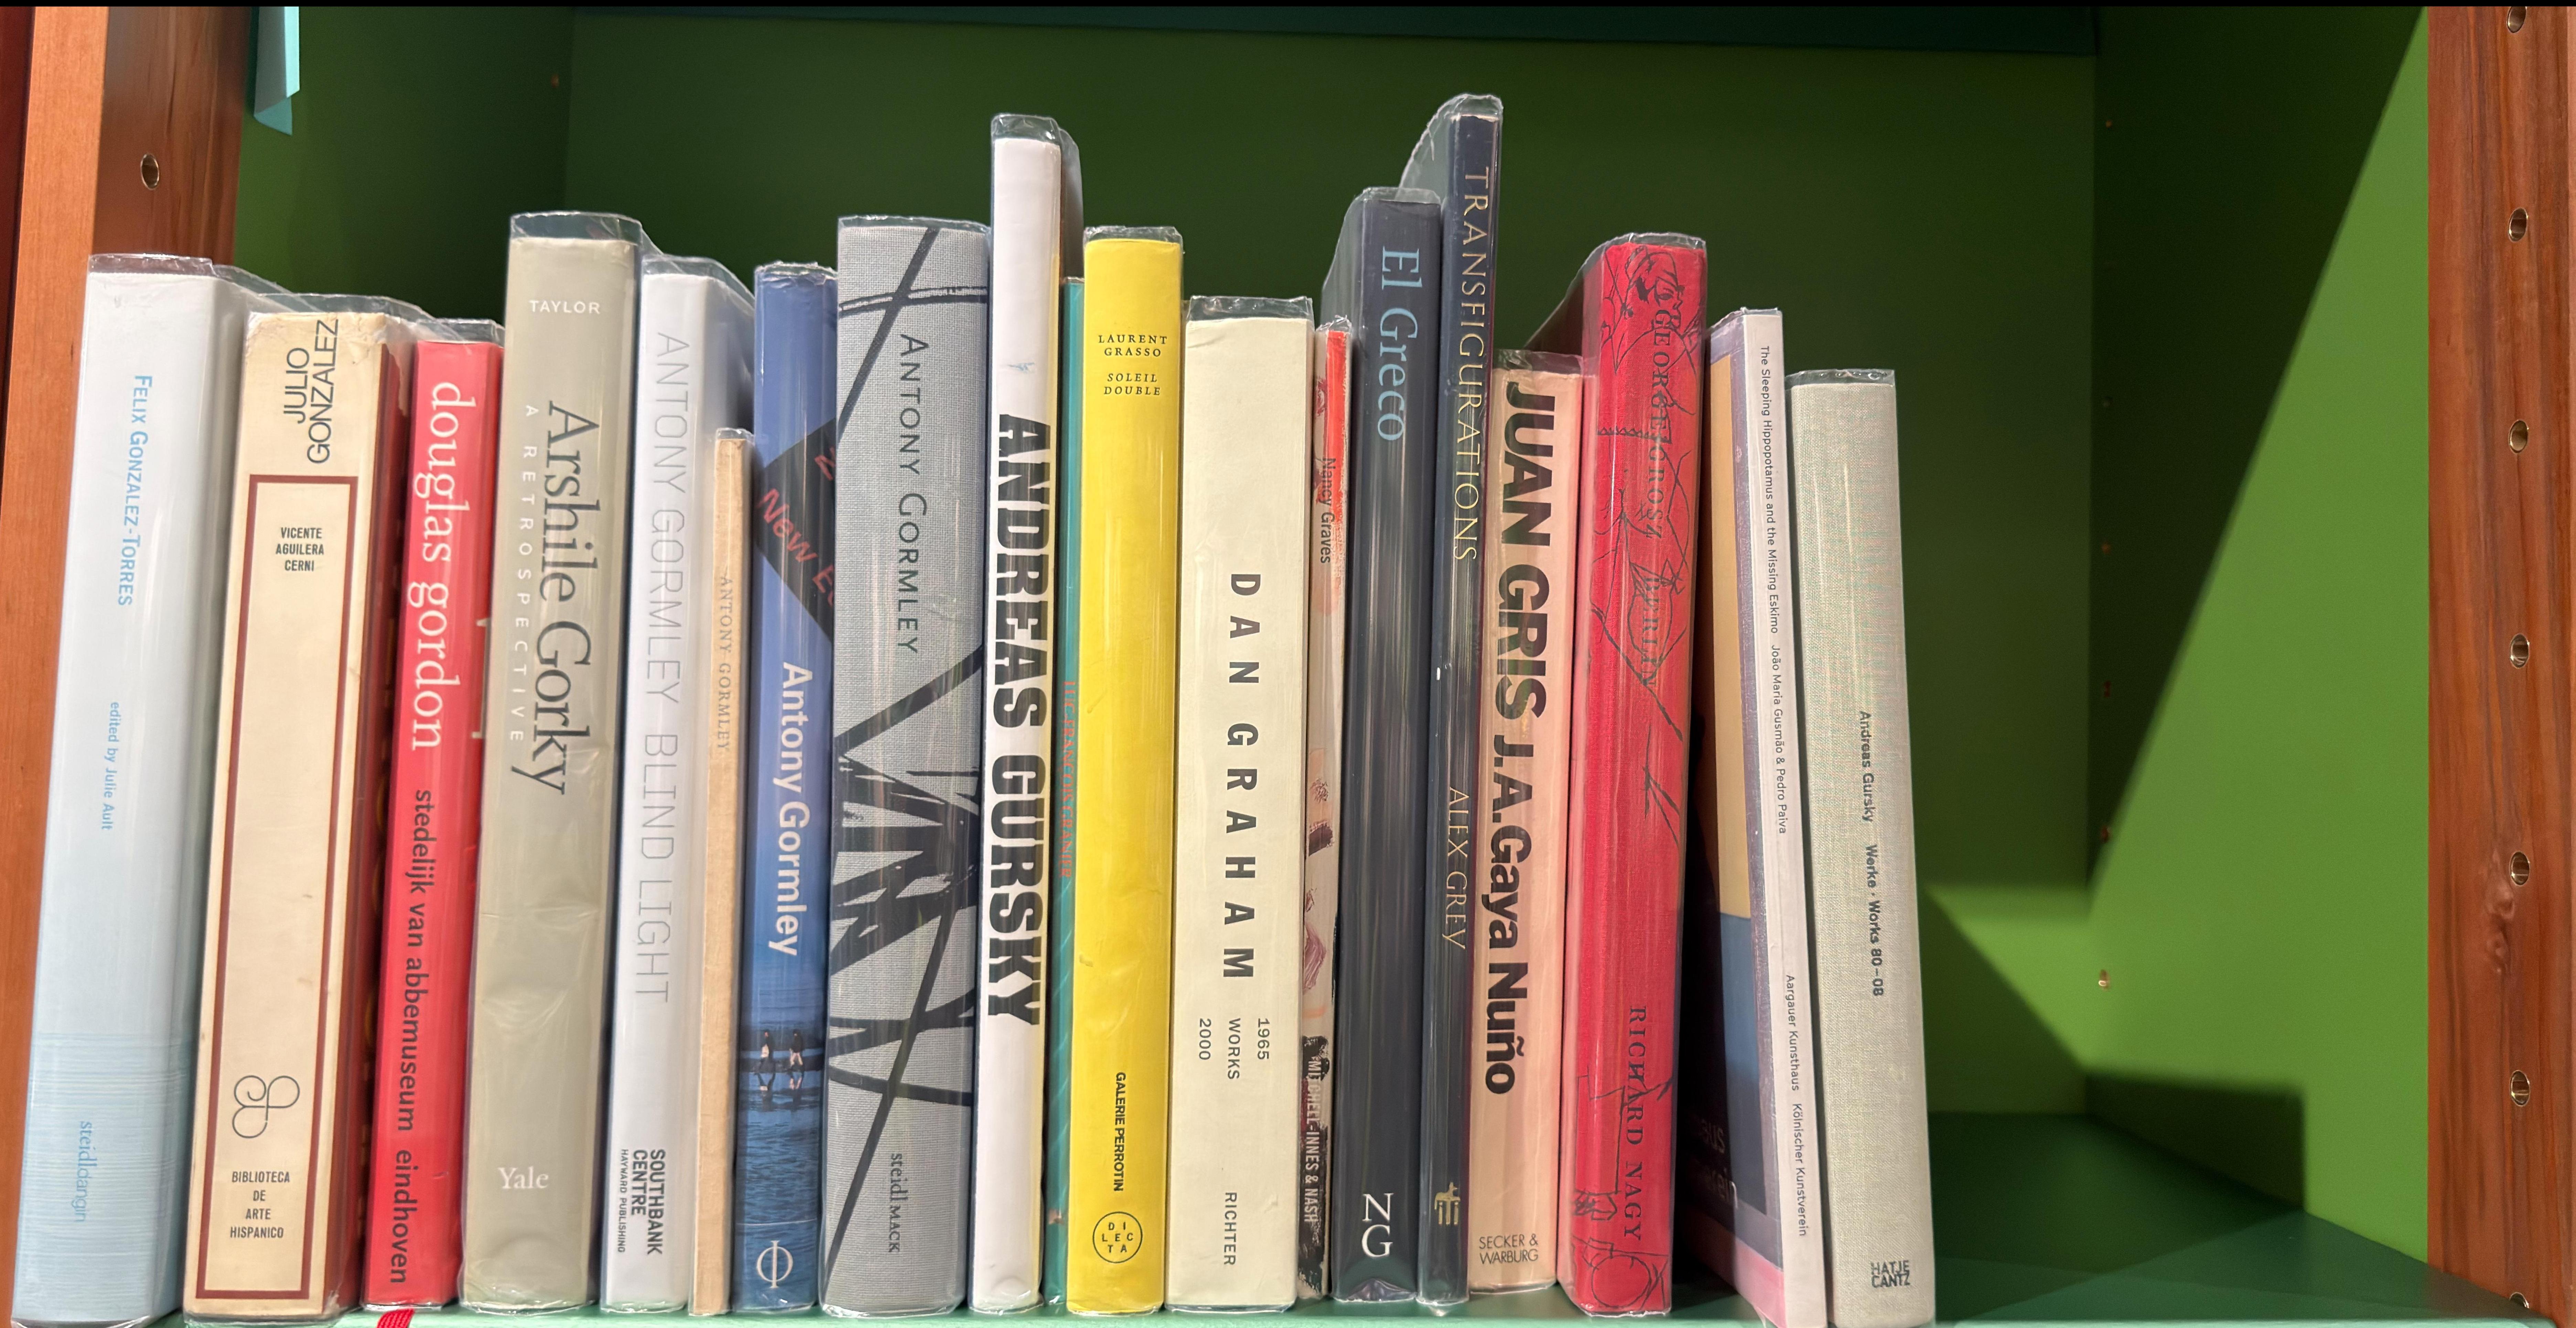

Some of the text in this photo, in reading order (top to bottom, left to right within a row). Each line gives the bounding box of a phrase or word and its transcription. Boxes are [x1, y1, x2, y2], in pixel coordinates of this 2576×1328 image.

[529, 300, 600, 315] TAYLOR
[1098, 334, 1167, 344] LAURENT
[1104, 348, 1161, 357] GRASSO
[1378, 246, 1422, 440] El Greco
[283, 347, 310, 424] JULIO
[307, 319, 339, 464] GONZALEZ
[1104, 387, 1160, 395] DOUBLE
[1108, 373, 1157, 382] SOLEIL
[1453, 167, 1489, 561] TRANSFIGURATIONS
[1651, 309, 1671, 431] GEORGE
[118, 375, 152, 606] FELIX GONZALEZ-TORRES
[898, 334, 929, 653] ANTONY GORMLEY
[1501, 381, 1555, 546] JUAN
[1646, 445, 1666, 538] GROSZ
[1761, 346, 1779, 633] The Sleeping Hippopotamus and the Missing Eskimo
[276, 543, 324, 556] AGUILERA
[280, 527, 322, 540] VICENTE
[1318, 458, 1336, 564] Nancy Graves
[284, 559, 315, 572] CERNI
[407, 382, 476, 751] douglas gordon
[510, 405, 539, 741] A RETROSPECTIVE
[511, 401, 601, 795] Arshile Gorky
[636, 332, 690, 1002] ANTONY GORMLEY BLIND LIGHT
[718, 577, 733, 749] ANTONY GORMLEY
[1496, 564, 1550, 720] GRIS
[1772, 645, 1781, 670] João
[988, 414, 1051, 1025] ANDREAS GURSKY
[1773, 675, 1782, 705] Maria
[1774, 709, 1784, 753] Gusmão
[100, 701, 120, 830] edited by Julie Ault
[768, 662, 812, 956] Antony Gormley
[1223, 574, 1261, 977] DAN GRAHAM
[1777, 769, 1787, 800] Pedro
[1860, 711, 1875, 822] Andreas Gursky
[1778, 804, 1788, 834] Paiva
[1442, 786, 1469, 949] ALEX GREY
[1869, 900, 1881, 944] Works
[390, 790, 435, 1284] stedelijk van abbemuseum eindhoven
[1198, 1018, 1211, 1060] 2000
[1228, 1018, 1241, 1080] WORKS
[1257, 1018, 1270, 1060] 1965
[1485, 963, 1528, 1094] Nuño
[1786, 975, 1799, 1090] Aargauer Kunsthaus
[1114, 1072, 1126, 1191] GALERIE PERROTIN
[1624, 1005, 1646, 1240] RICHARD NAGY
[71, 1121, 97, 1222] steidldangin
[232, 1171, 290, 1183] BIBLIOTECA
[246, 1209, 271, 1220] ARTE
[253, 1190, 266, 1201] DE
[498, 1166, 549, 1190] Yale
[617, 1149, 629, 1252] HAYWARD PUBLISHING
[631, 1149, 648, 1216] CENTRE
[647, 1149, 666, 1255] SOUTHBANK
[1304, 1188, 1318, 1222] NASH
[1792, 1104, 1808, 1236] Kölnischer Kunstverein
[230, 1227, 283, 1238] HISPANICO
[1224, 1192, 1237, 1265] RICHTER
[1479, 1233, 1538, 1249] SECKER &
[1480, 1249, 1538, 1265] WARBURG
[1871, 1260, 1910, 1275] HATJE
[1871, 1273, 1910, 1288] CANTZ
